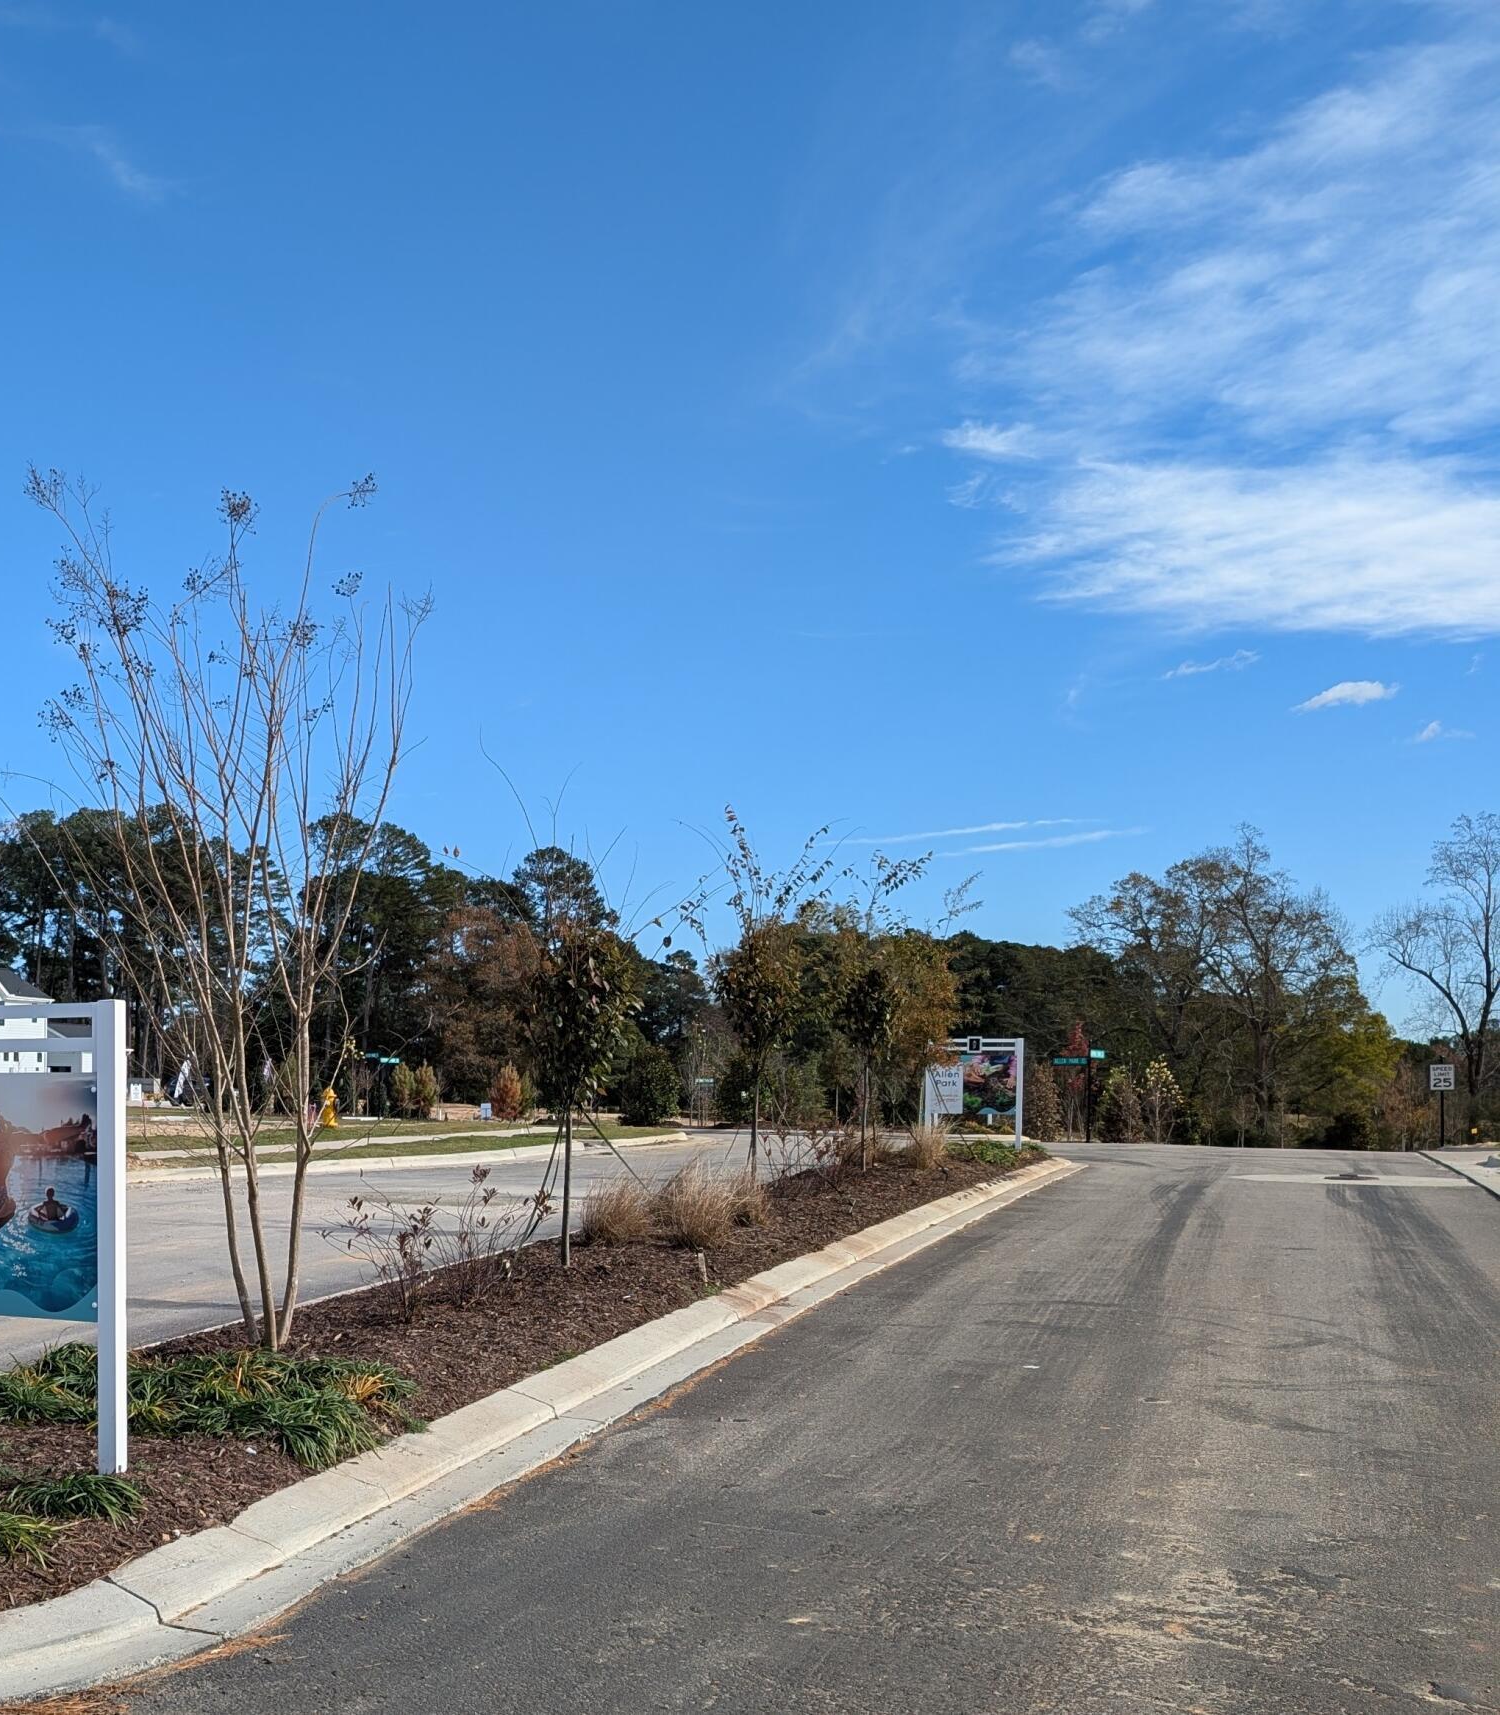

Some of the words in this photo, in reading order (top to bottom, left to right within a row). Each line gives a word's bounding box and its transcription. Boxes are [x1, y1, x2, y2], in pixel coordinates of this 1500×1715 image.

[934, 1070, 960, 1078] Allen
[936, 1079, 957, 1087] Park
[1433, 1077, 1452, 1088] 25
